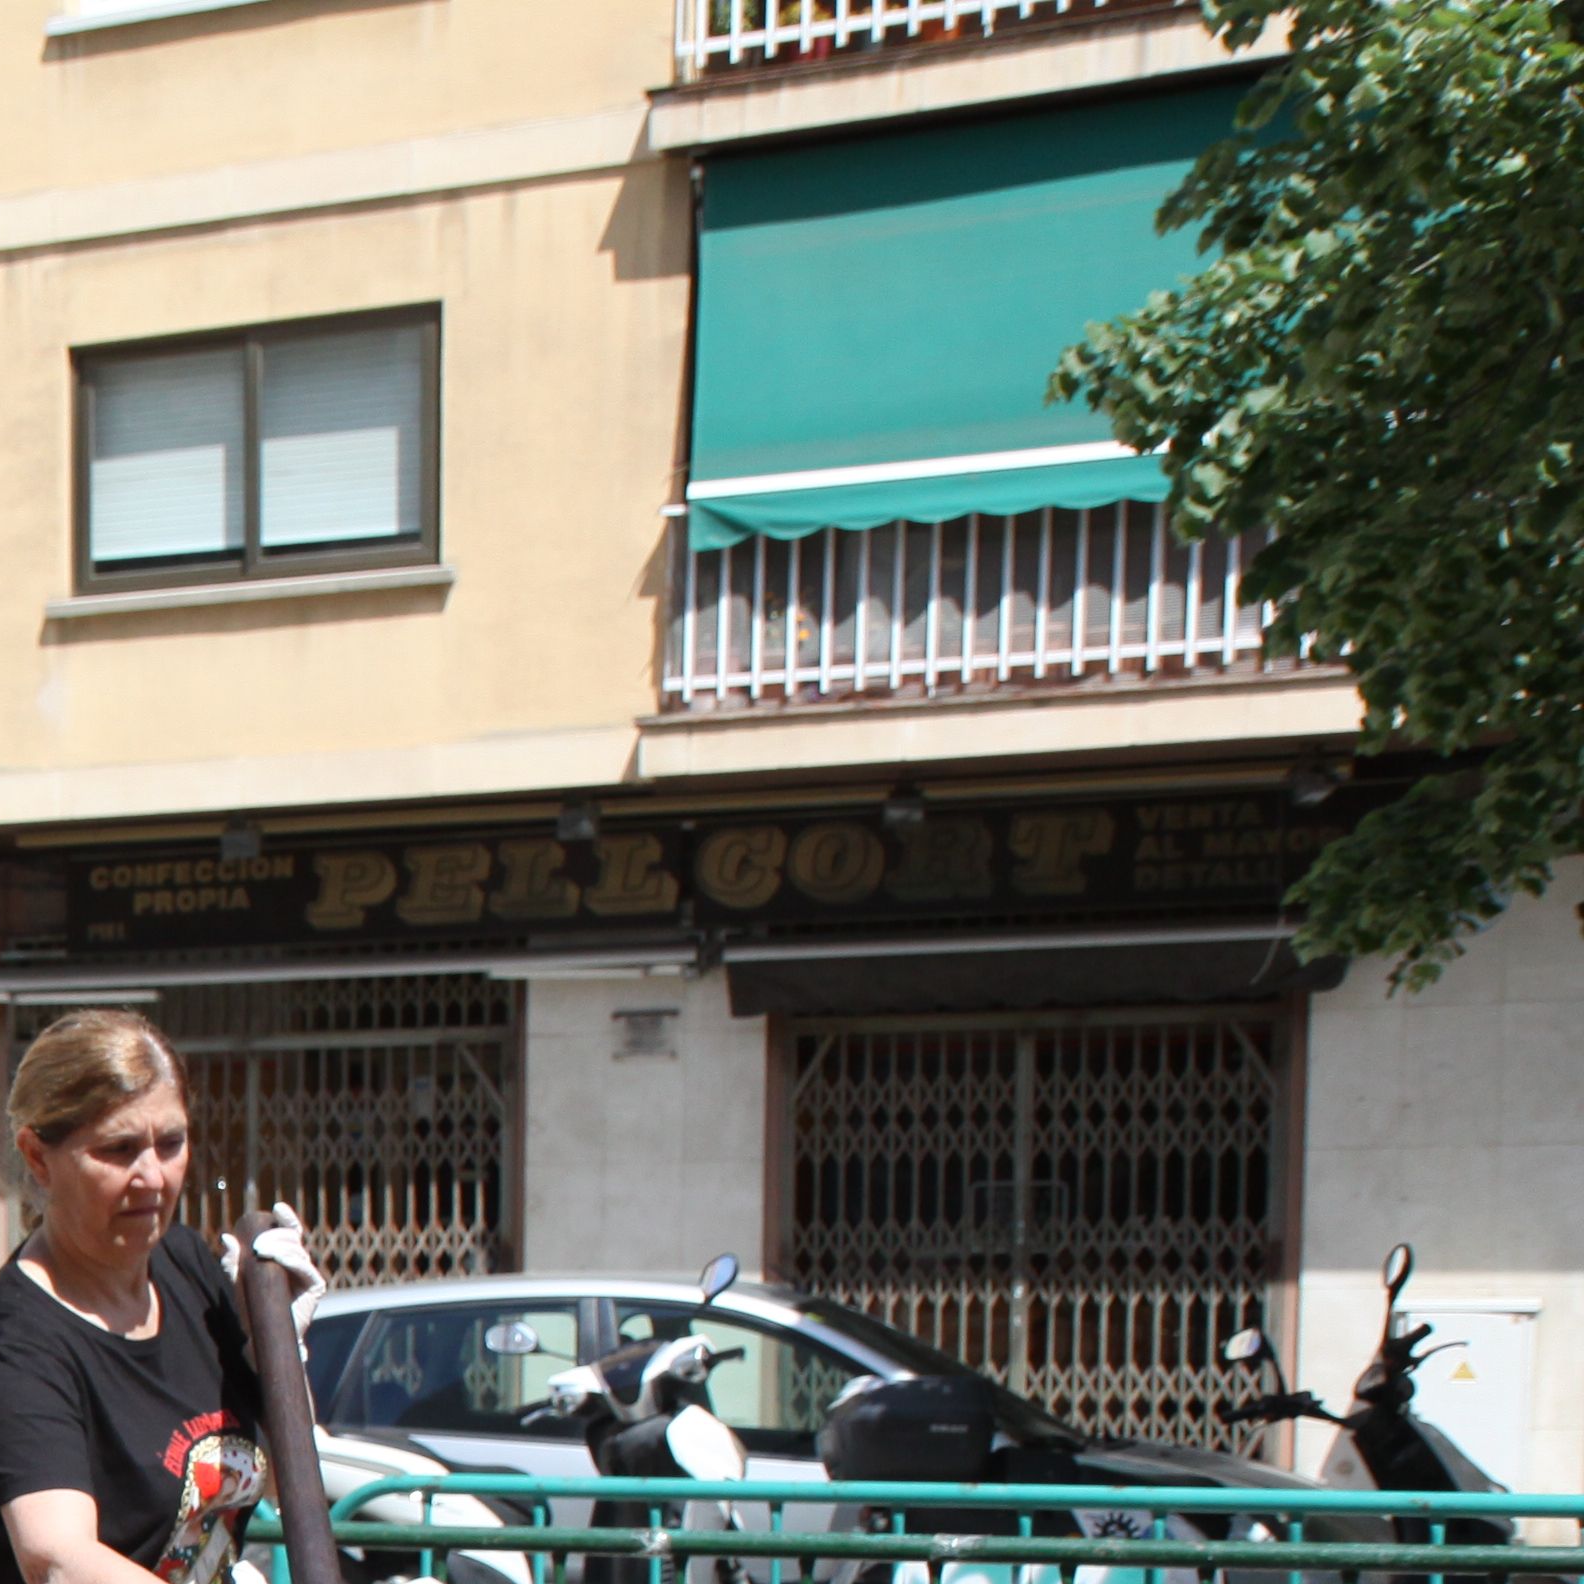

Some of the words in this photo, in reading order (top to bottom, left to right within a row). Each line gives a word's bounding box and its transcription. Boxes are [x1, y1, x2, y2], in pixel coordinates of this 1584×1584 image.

[1136, 802, 1262, 830] VENTA
[1135, 834, 1184, 861] AL
[306, 807, 1115, 931] PELLCORT
[133, 887, 250, 916] PROPIA
